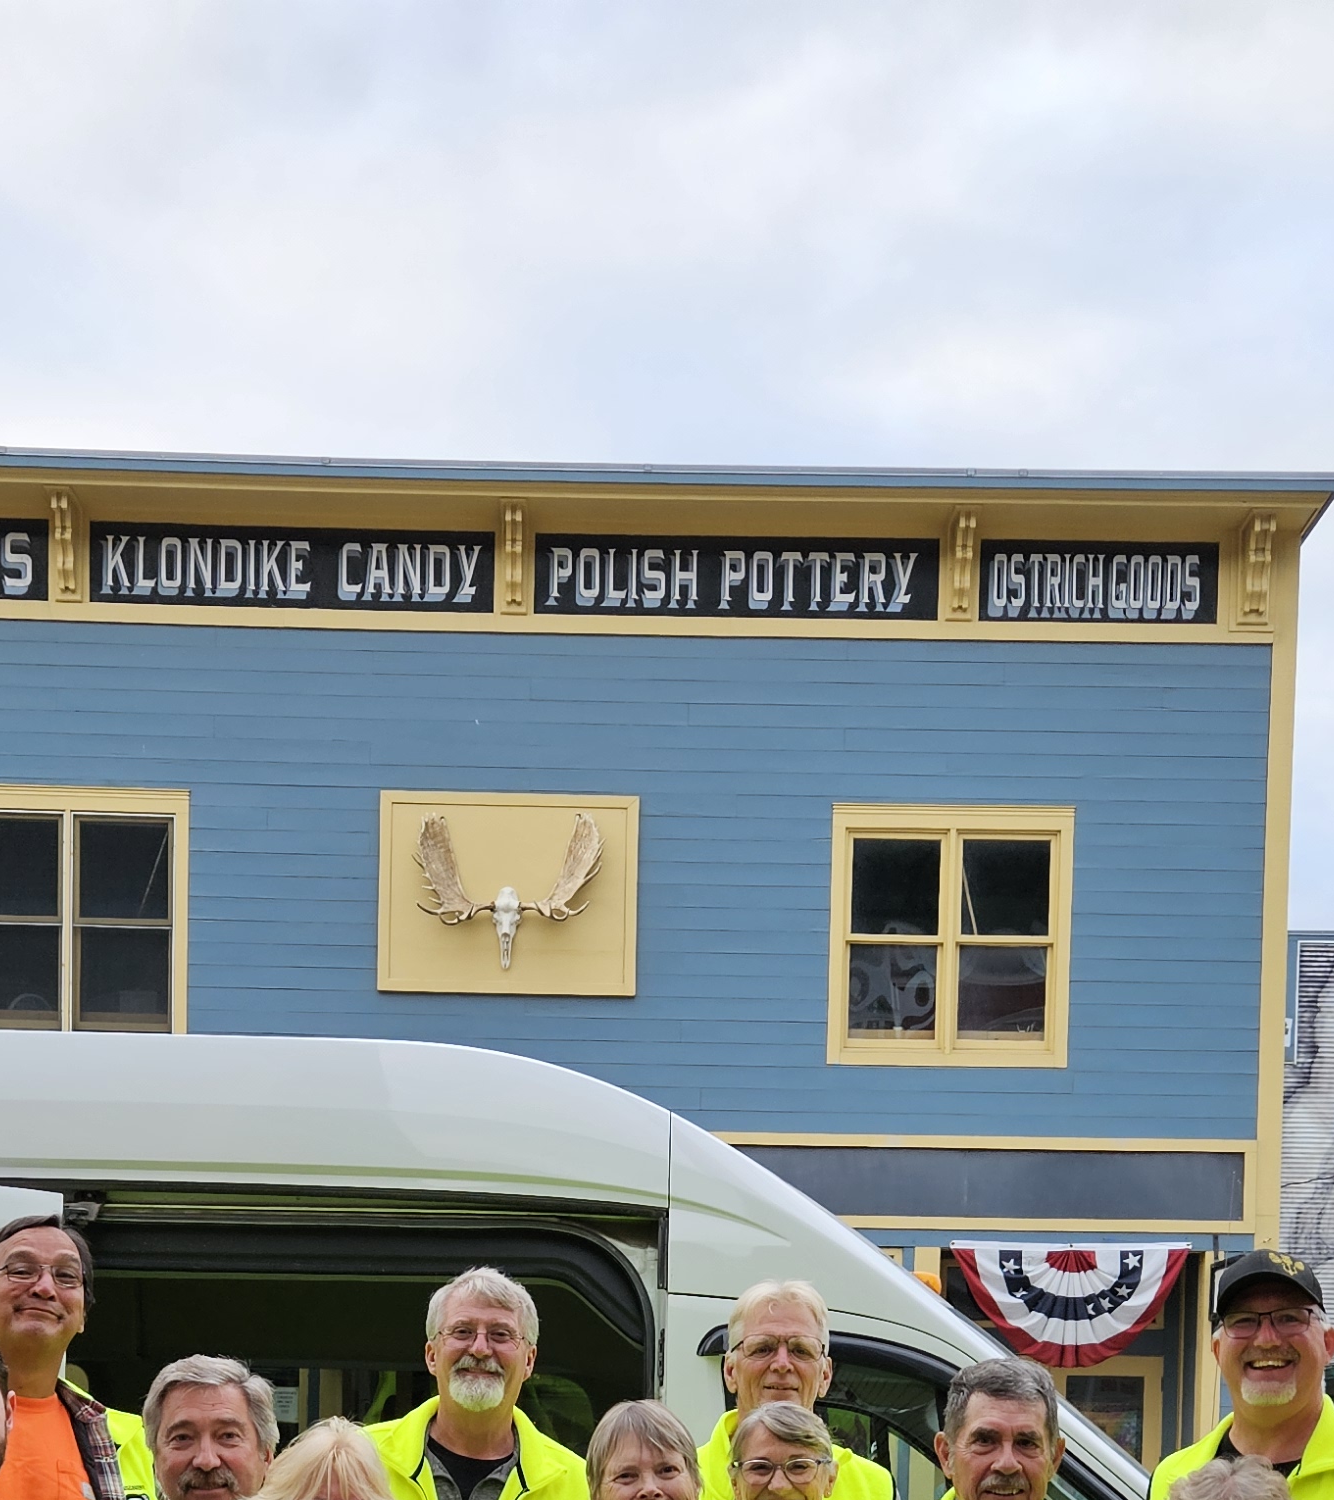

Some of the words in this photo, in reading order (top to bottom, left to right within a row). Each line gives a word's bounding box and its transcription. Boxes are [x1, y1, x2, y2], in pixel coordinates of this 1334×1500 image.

[101, 534, 311, 600] KLONDIKE
[338, 542, 482, 602] CANDY
[546, 547, 701, 609] POLISH
[719, 551, 919, 613] POTTERY
[988, 553, 1106, 618] OSTRICH
[1107, 554, 1201, 619] GOODS
